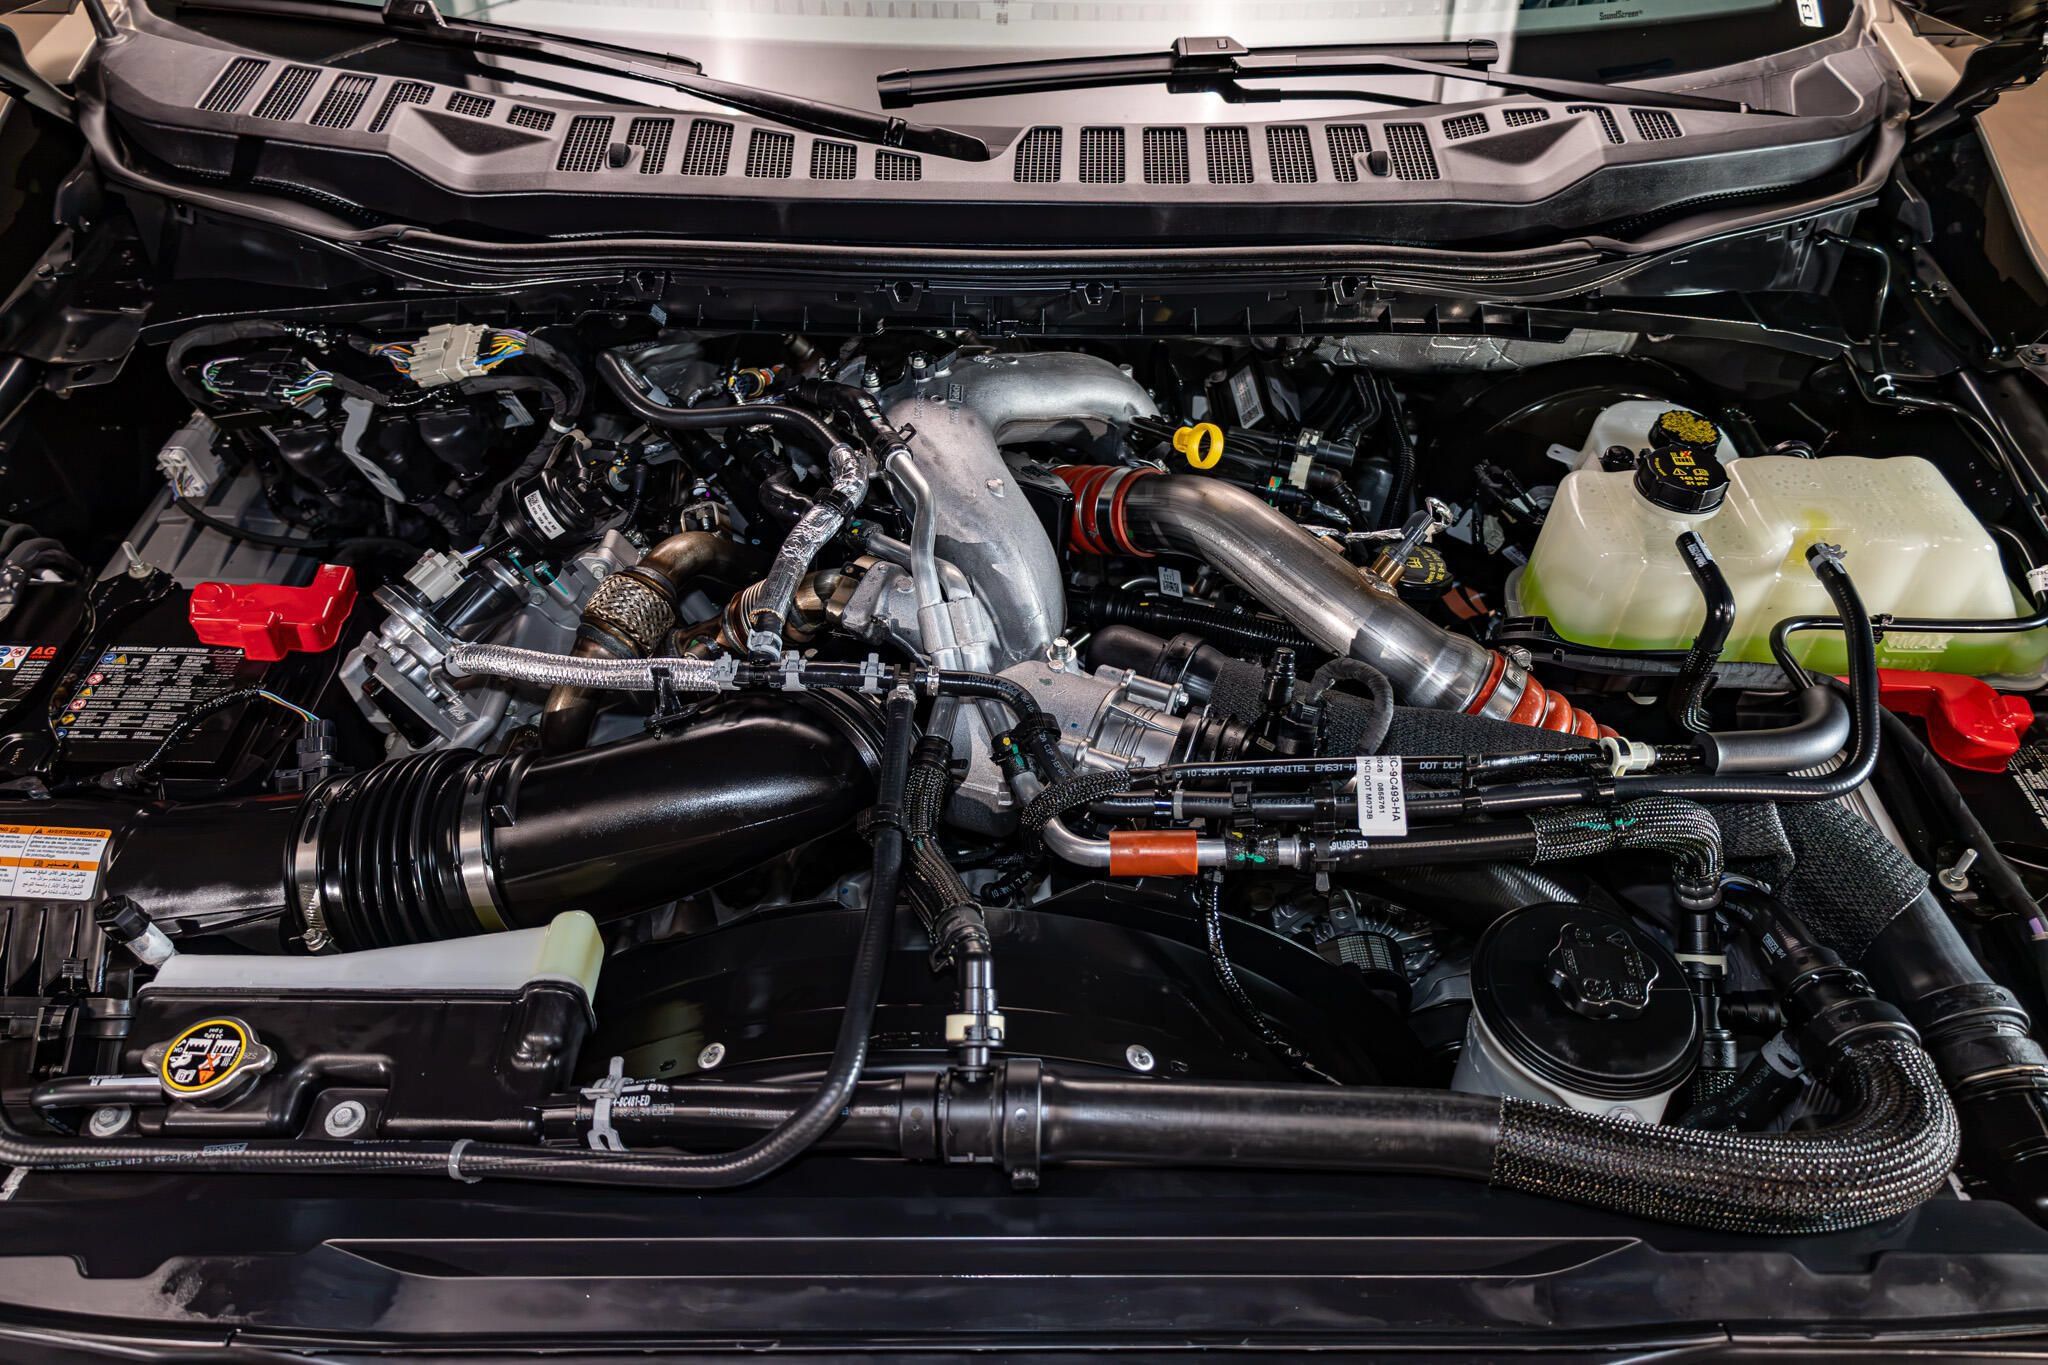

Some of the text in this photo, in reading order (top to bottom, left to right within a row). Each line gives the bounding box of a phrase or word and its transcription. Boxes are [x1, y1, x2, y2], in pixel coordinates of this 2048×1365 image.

[1268, 764, 1311, 774] ARNITEL
[1419, 761, 1438, 770] DOT
[1364, 775, 1372, 791] DOT
